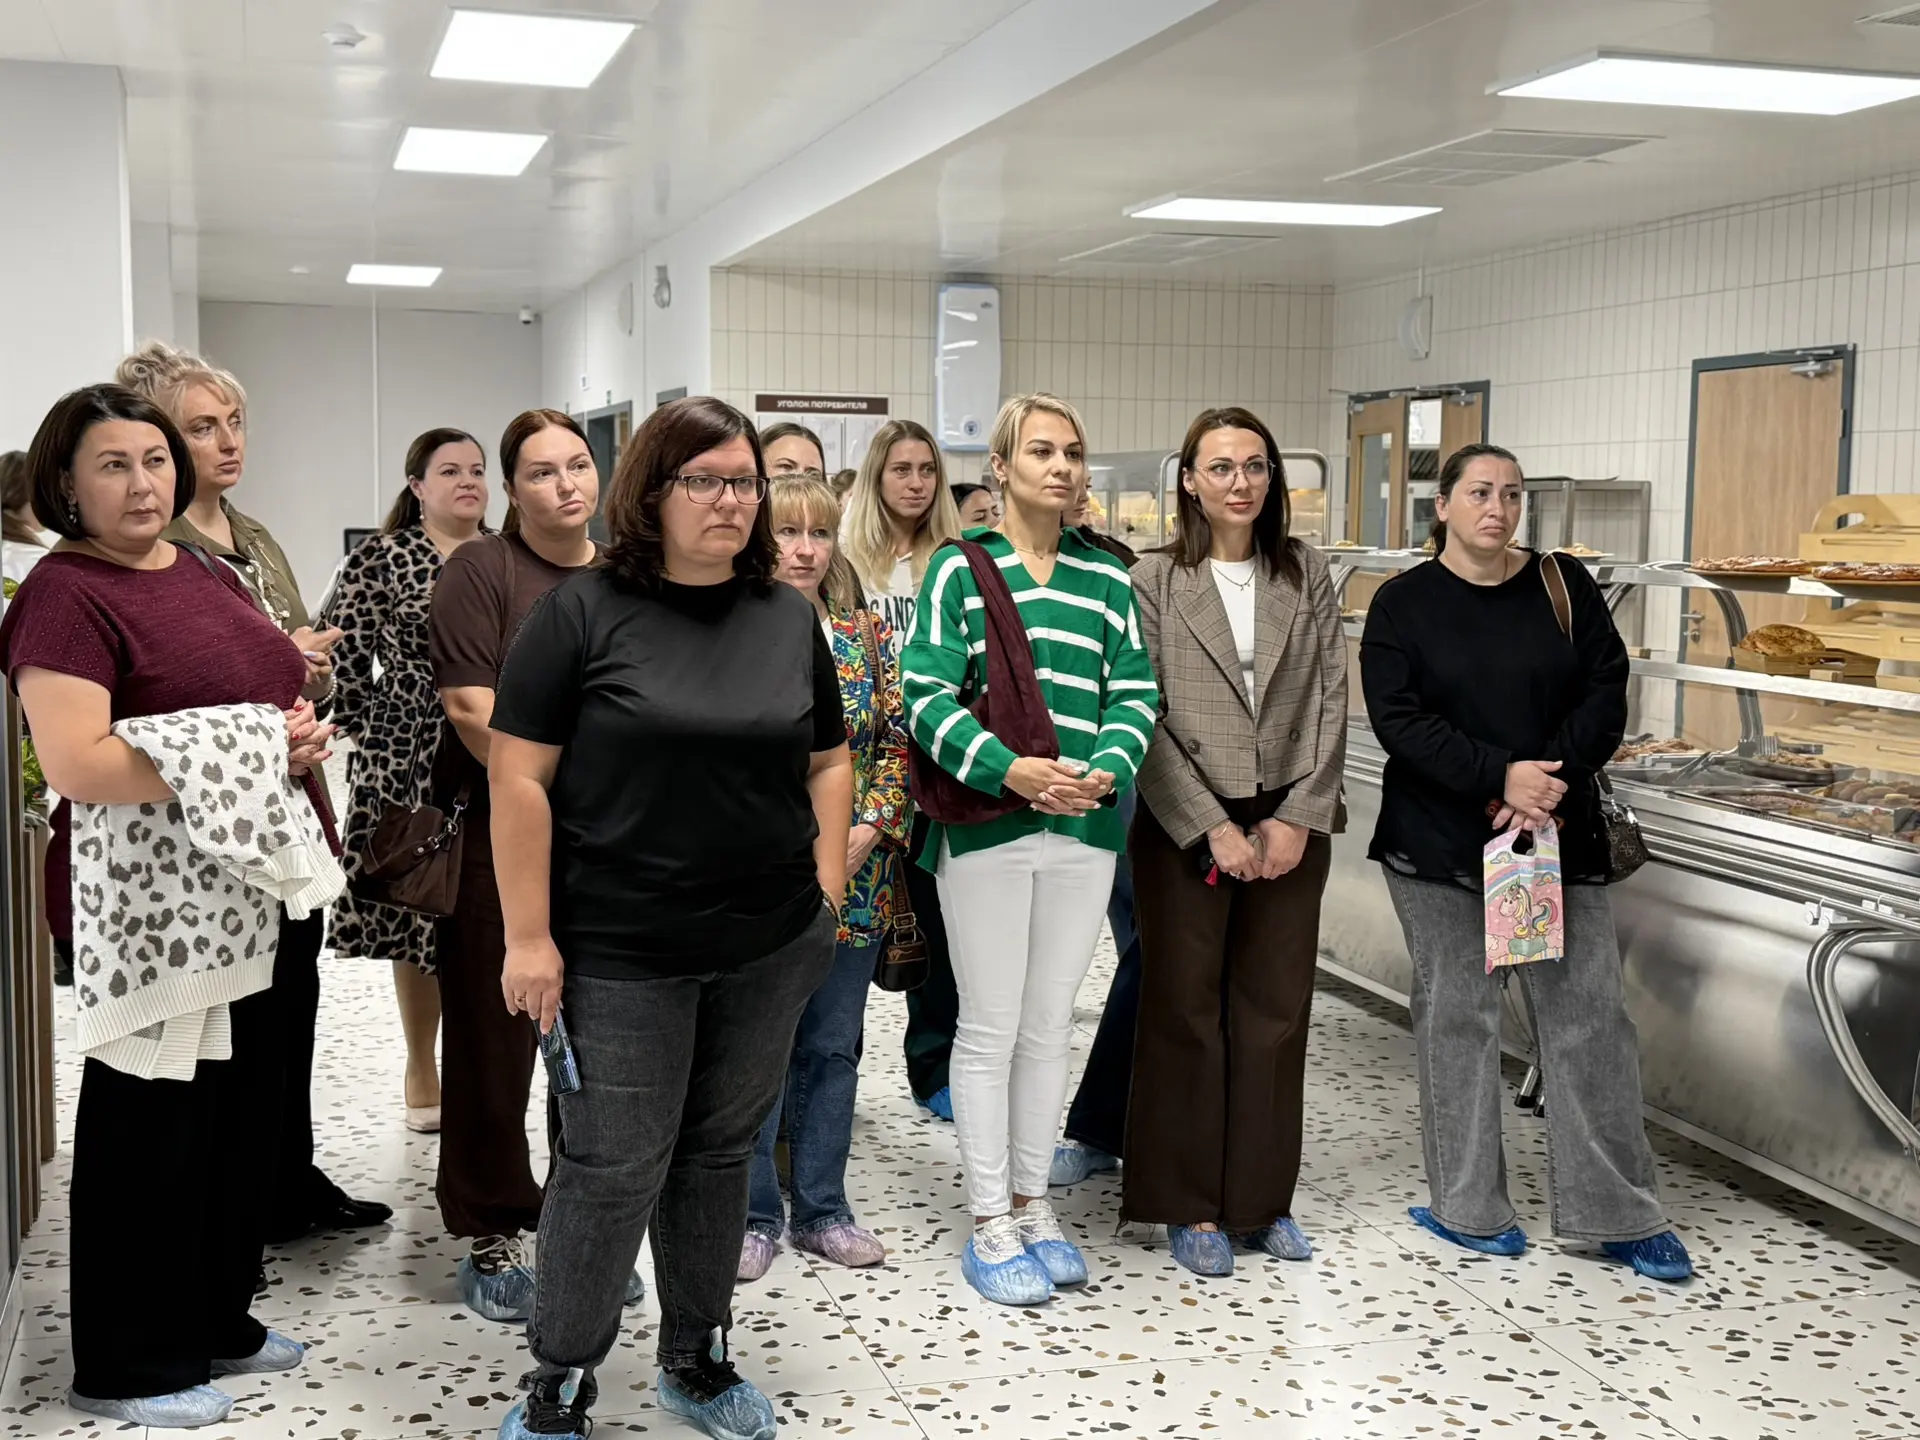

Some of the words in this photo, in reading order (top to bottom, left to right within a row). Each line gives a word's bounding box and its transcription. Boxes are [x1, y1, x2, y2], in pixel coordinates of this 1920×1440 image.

[777, 400, 810, 408] УГОЛОК
[811, 401, 868, 410] ПОТРЕБИТЕЛЯ
[884, 596, 918, 632] ANG
